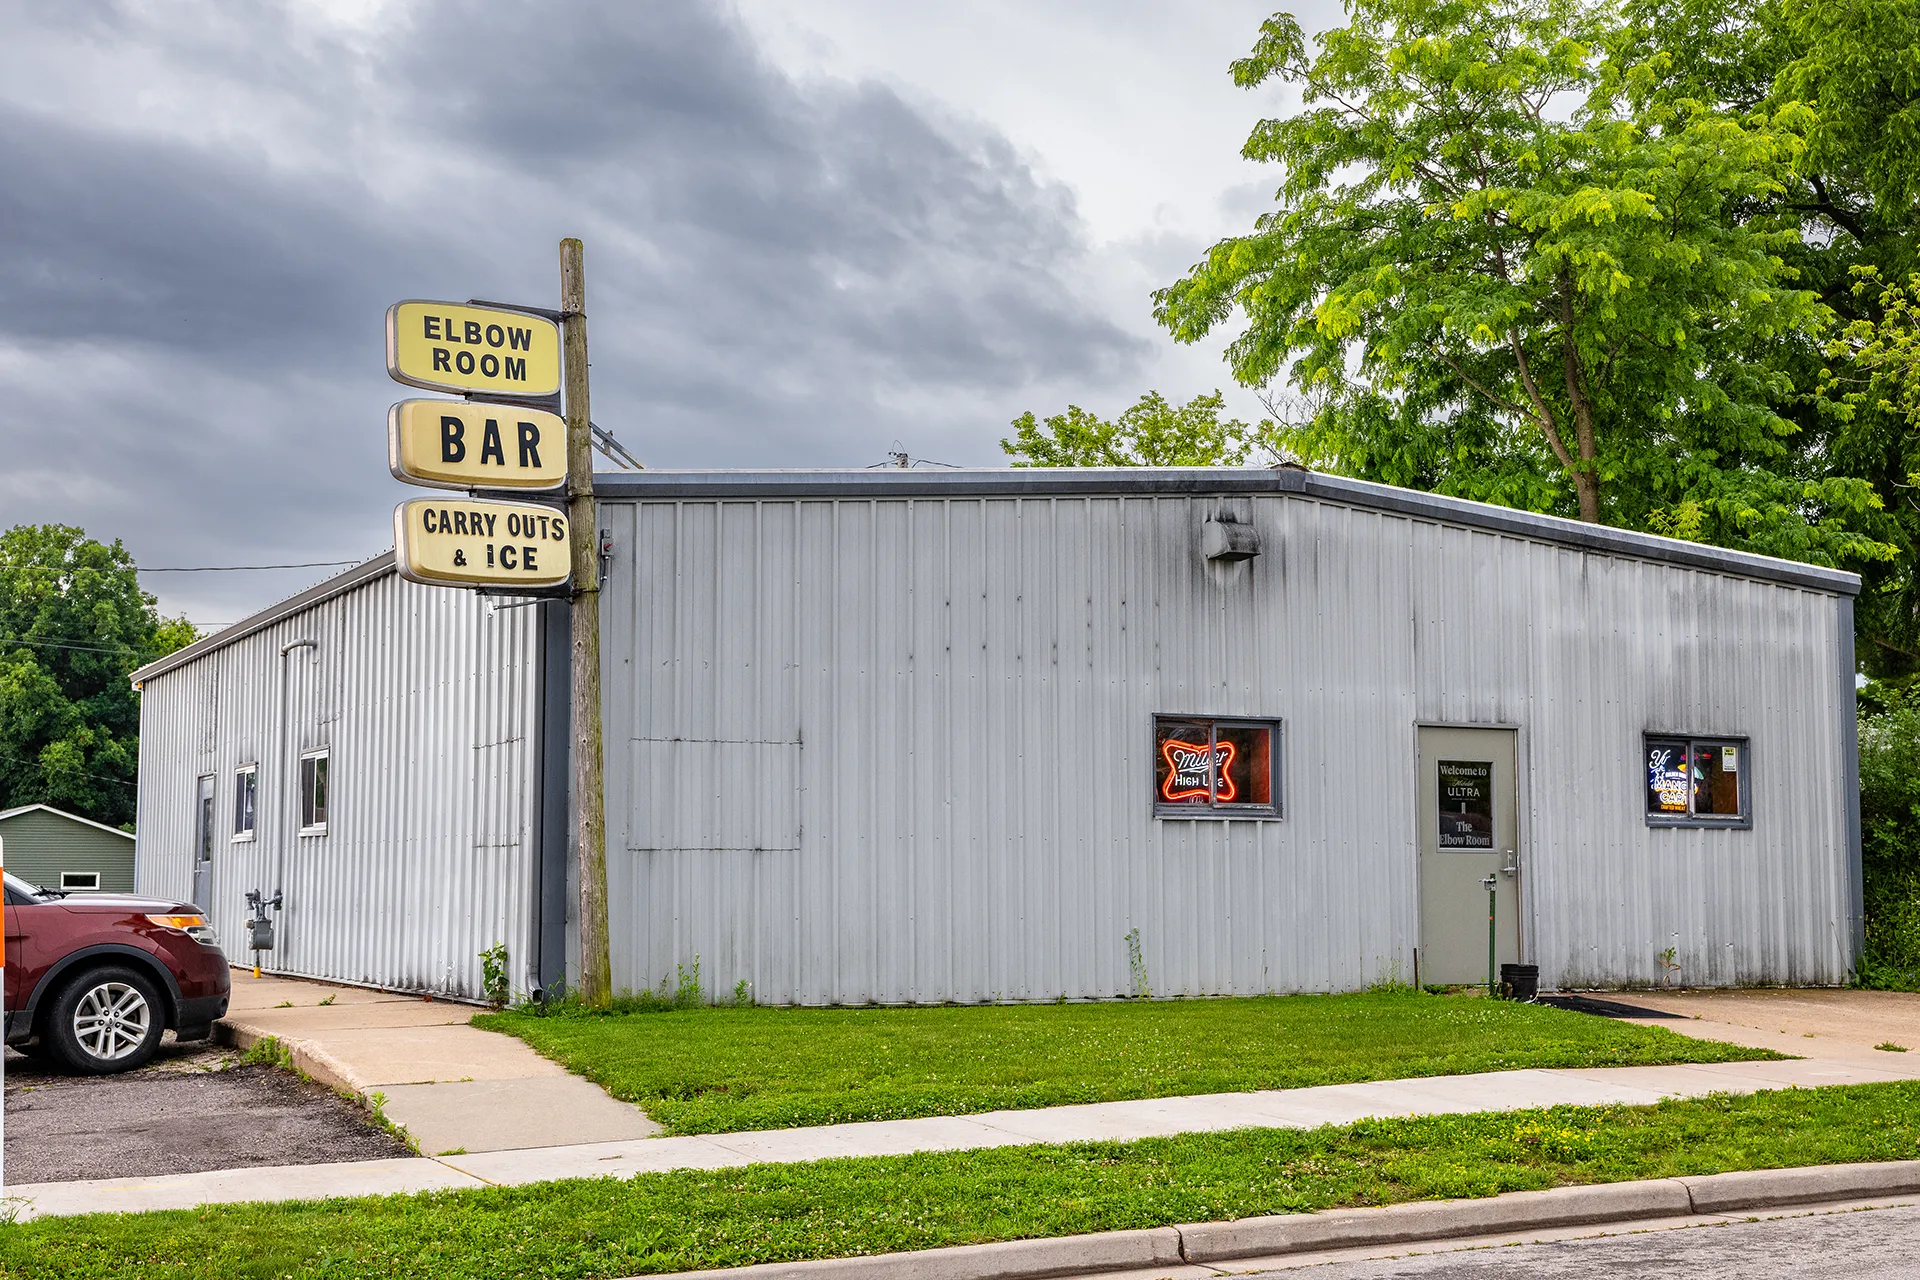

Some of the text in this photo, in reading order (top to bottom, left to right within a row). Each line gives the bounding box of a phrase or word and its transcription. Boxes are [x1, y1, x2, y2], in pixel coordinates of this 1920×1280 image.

[423, 315, 532, 352] ELBOW
[432, 347, 527, 382] ROOM
[440, 416, 542, 468] BAR
[423, 508, 565, 541] CARRY OUTS
[453, 544, 538, 571] & ICE
[1440, 765, 1487, 777] Welcome to
[1175, 774, 1224, 787] HIGH LE
[1654, 779, 1697, 793] MANG
[1448, 787, 1480, 797] ULTRA
[1456, 821, 1473, 832] The
[1439, 833, 1490, 846] Elbow Room
